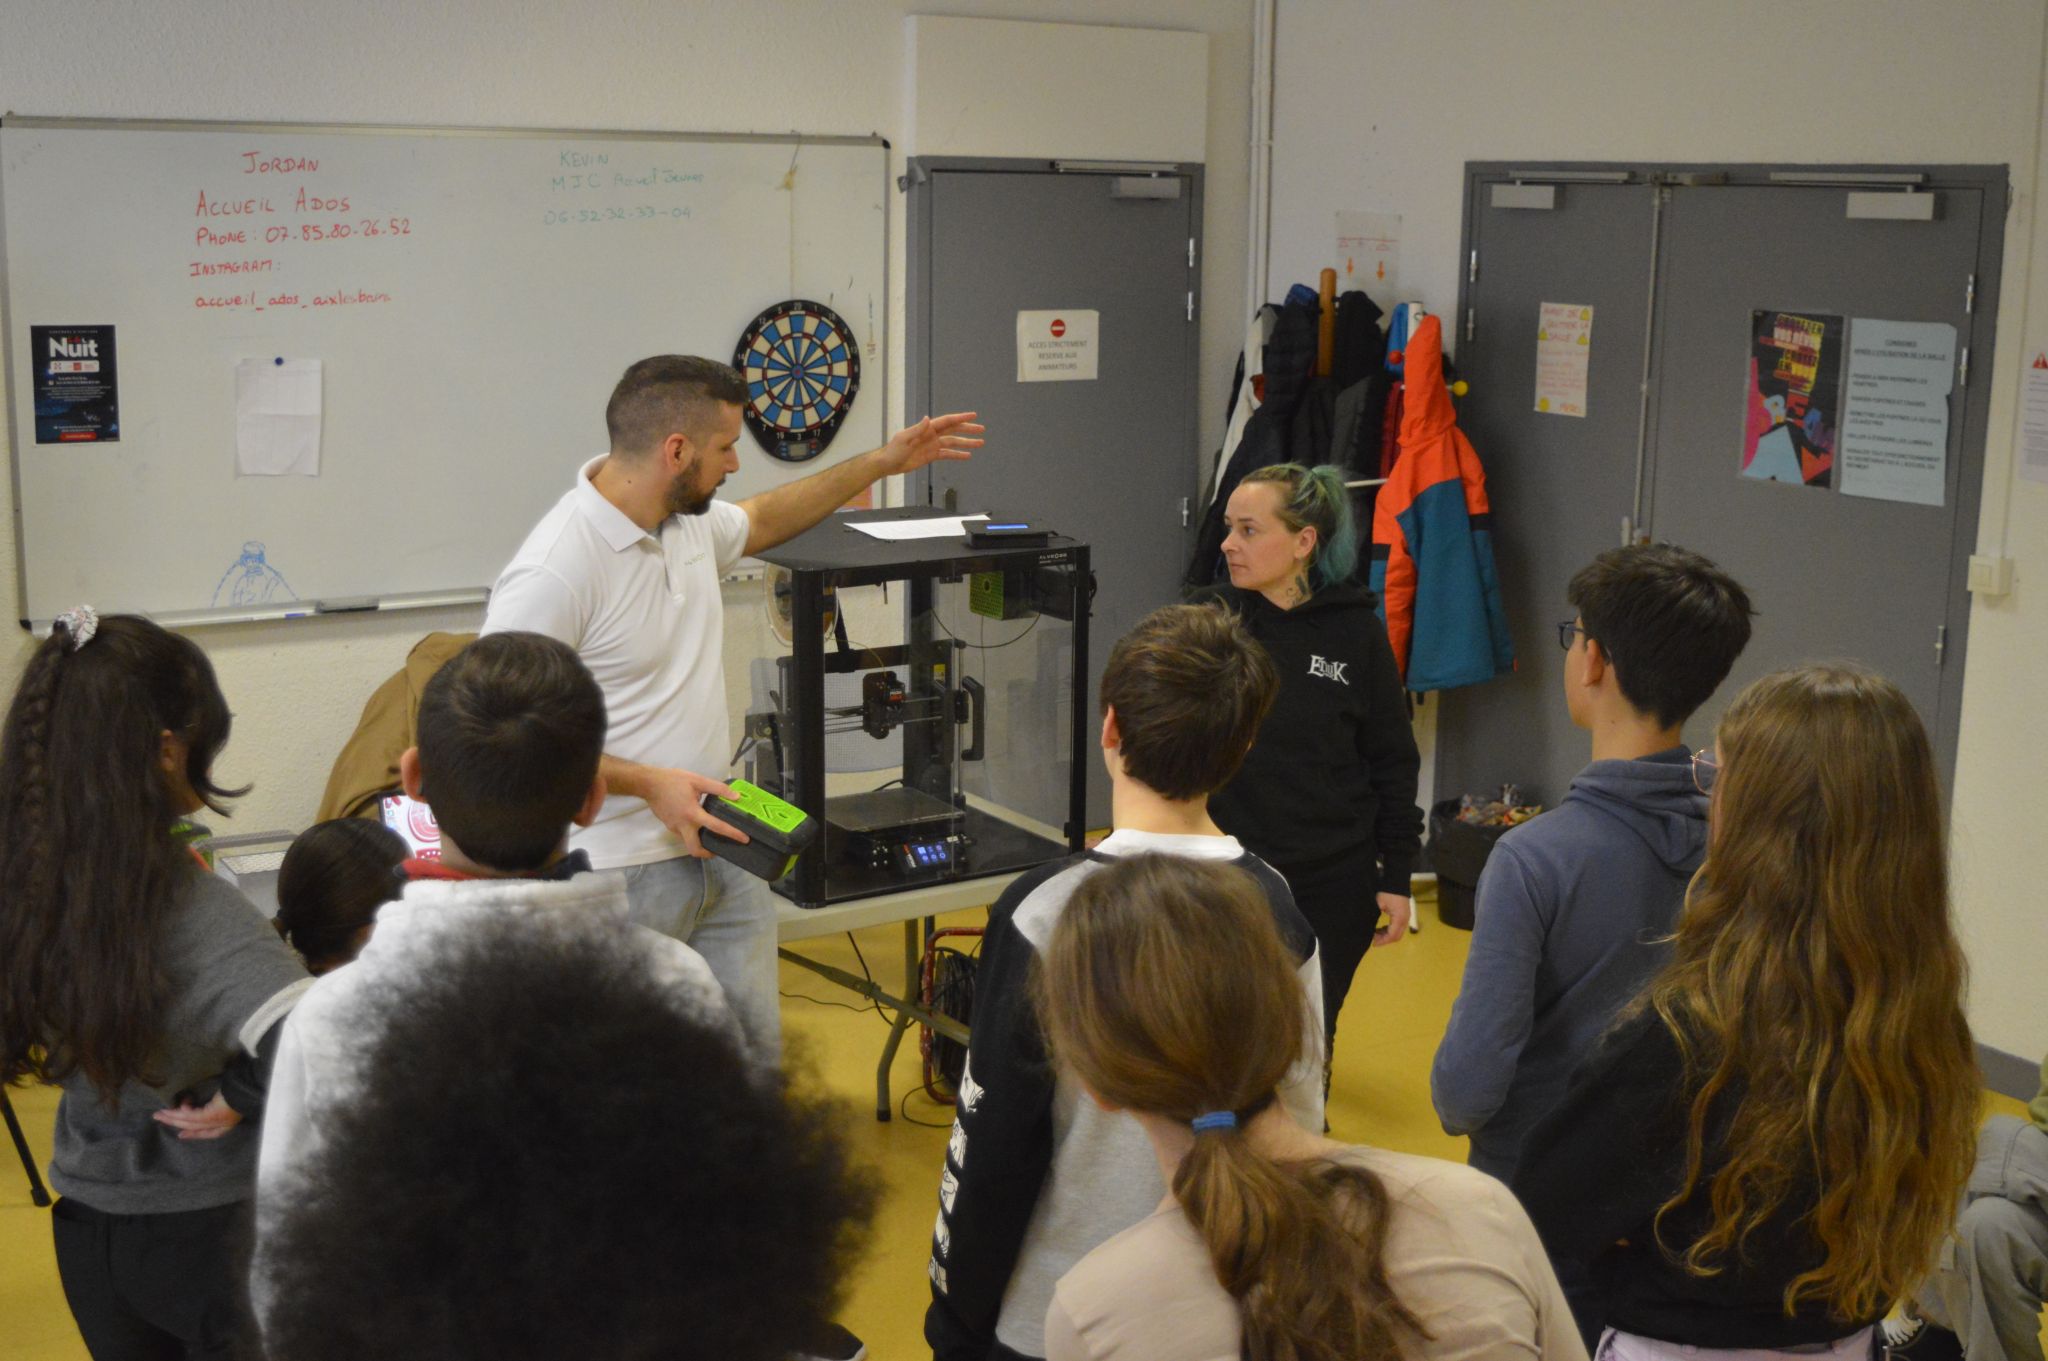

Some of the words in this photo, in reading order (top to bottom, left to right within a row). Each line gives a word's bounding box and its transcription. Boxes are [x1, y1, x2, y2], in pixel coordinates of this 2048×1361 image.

[242, 151, 319, 174] JORDAN
[559, 151, 609, 168] KEVIN
[196, 189, 275, 217] ACCUEIL
[295, 186, 351, 213] ADOS
[49, 336, 99, 358] Nuit
